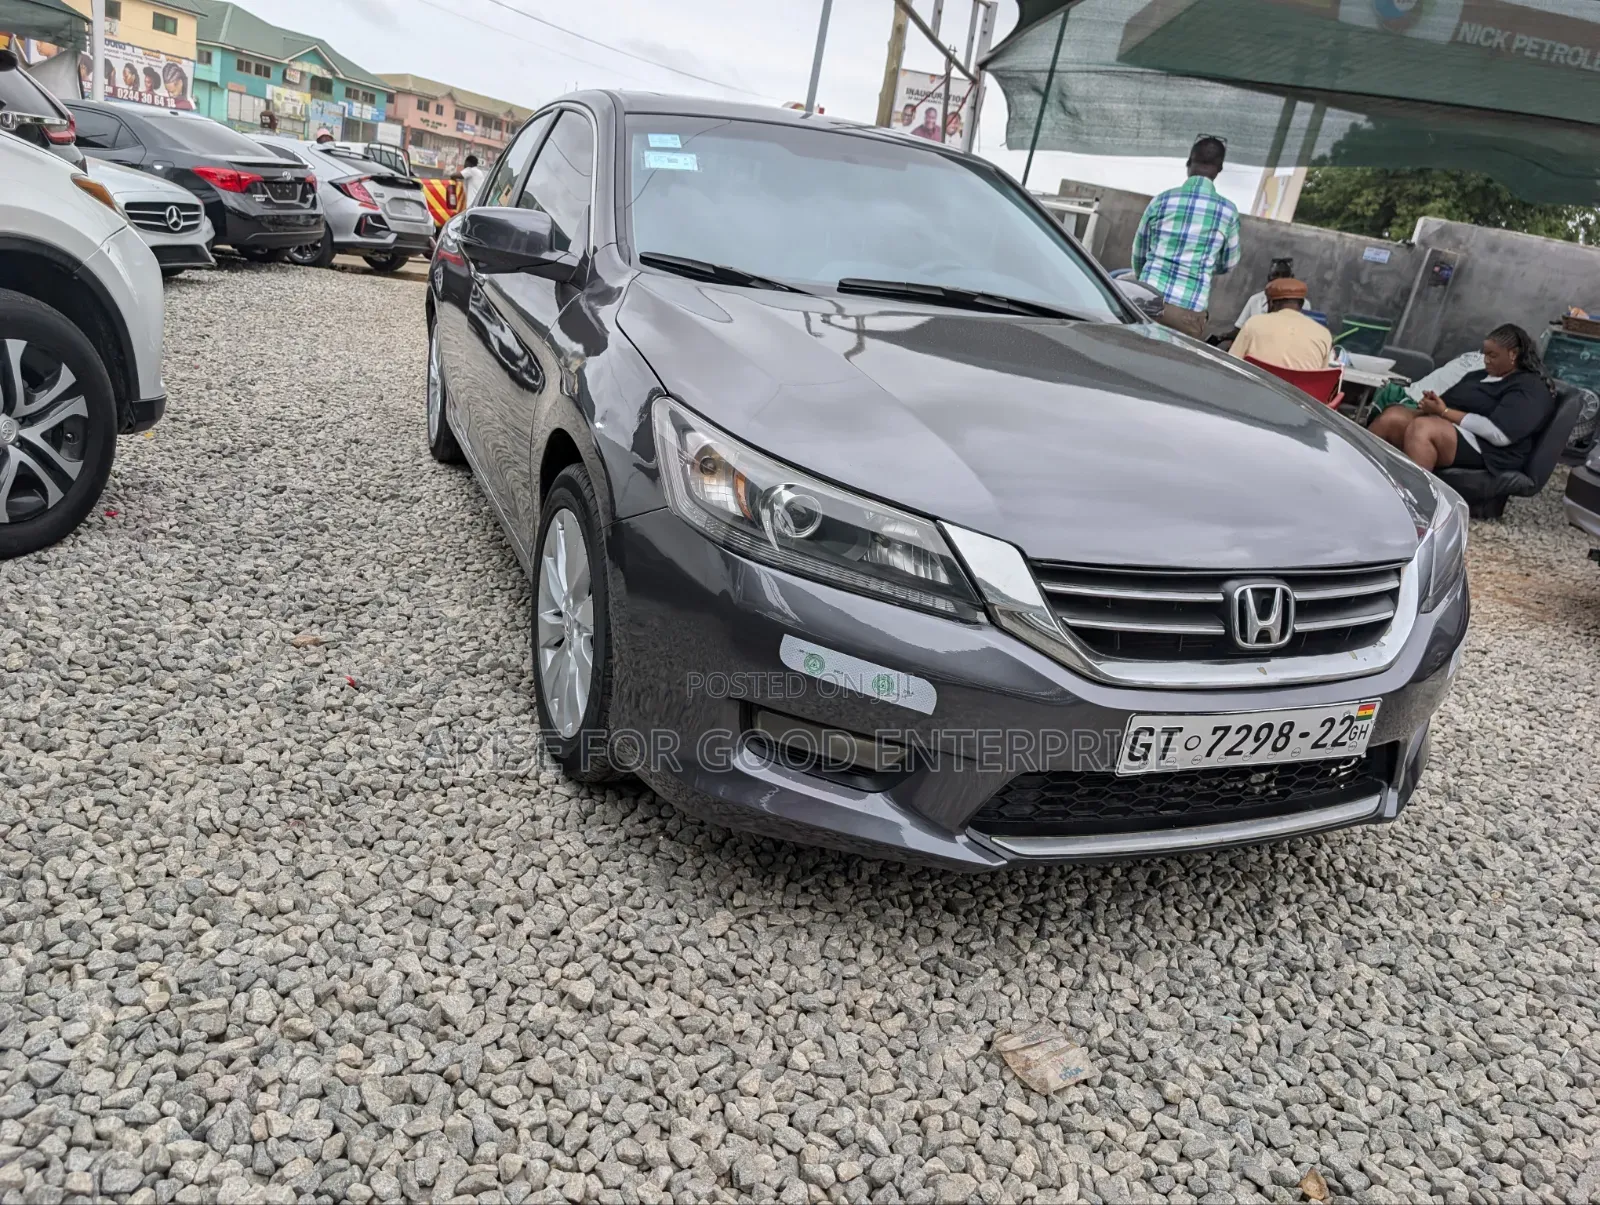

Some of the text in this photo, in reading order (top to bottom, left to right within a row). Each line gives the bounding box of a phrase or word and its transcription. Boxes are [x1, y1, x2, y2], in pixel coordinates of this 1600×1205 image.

[1456, 21, 1511, 51] NICK
[117, 88, 140, 102] 0244
[141, 93, 153, 104] 30
[905, 87, 966, 104] INAUGURTIO
[1127, 714, 1369, 762] GT 7298-22 GH
